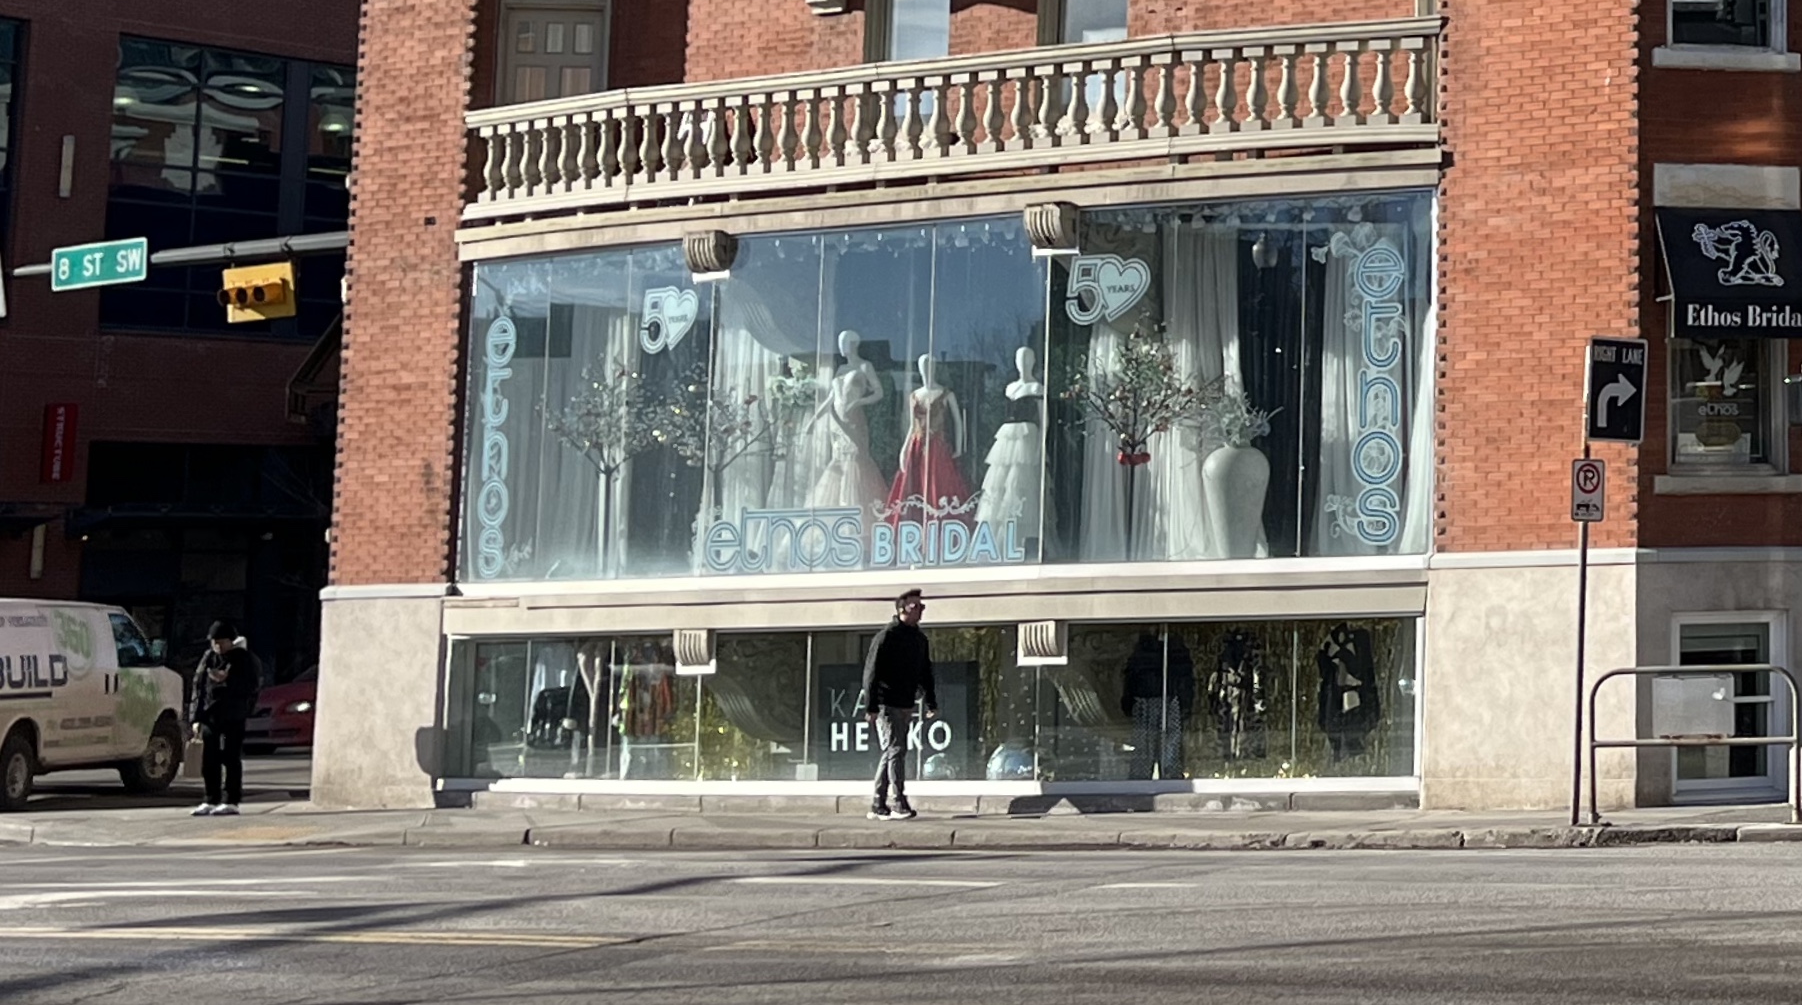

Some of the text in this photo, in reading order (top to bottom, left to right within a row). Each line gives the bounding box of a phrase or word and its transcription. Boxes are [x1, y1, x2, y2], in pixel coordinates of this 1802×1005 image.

[58, 248, 142, 280] 8 ST SW
[1106, 283, 1136, 293] YEARS
[1686, 303, 1742, 327] Ethos
[1593, 345, 1644, 365] RIGHT LANE
[871, 517, 1025, 568] BRIDAL
